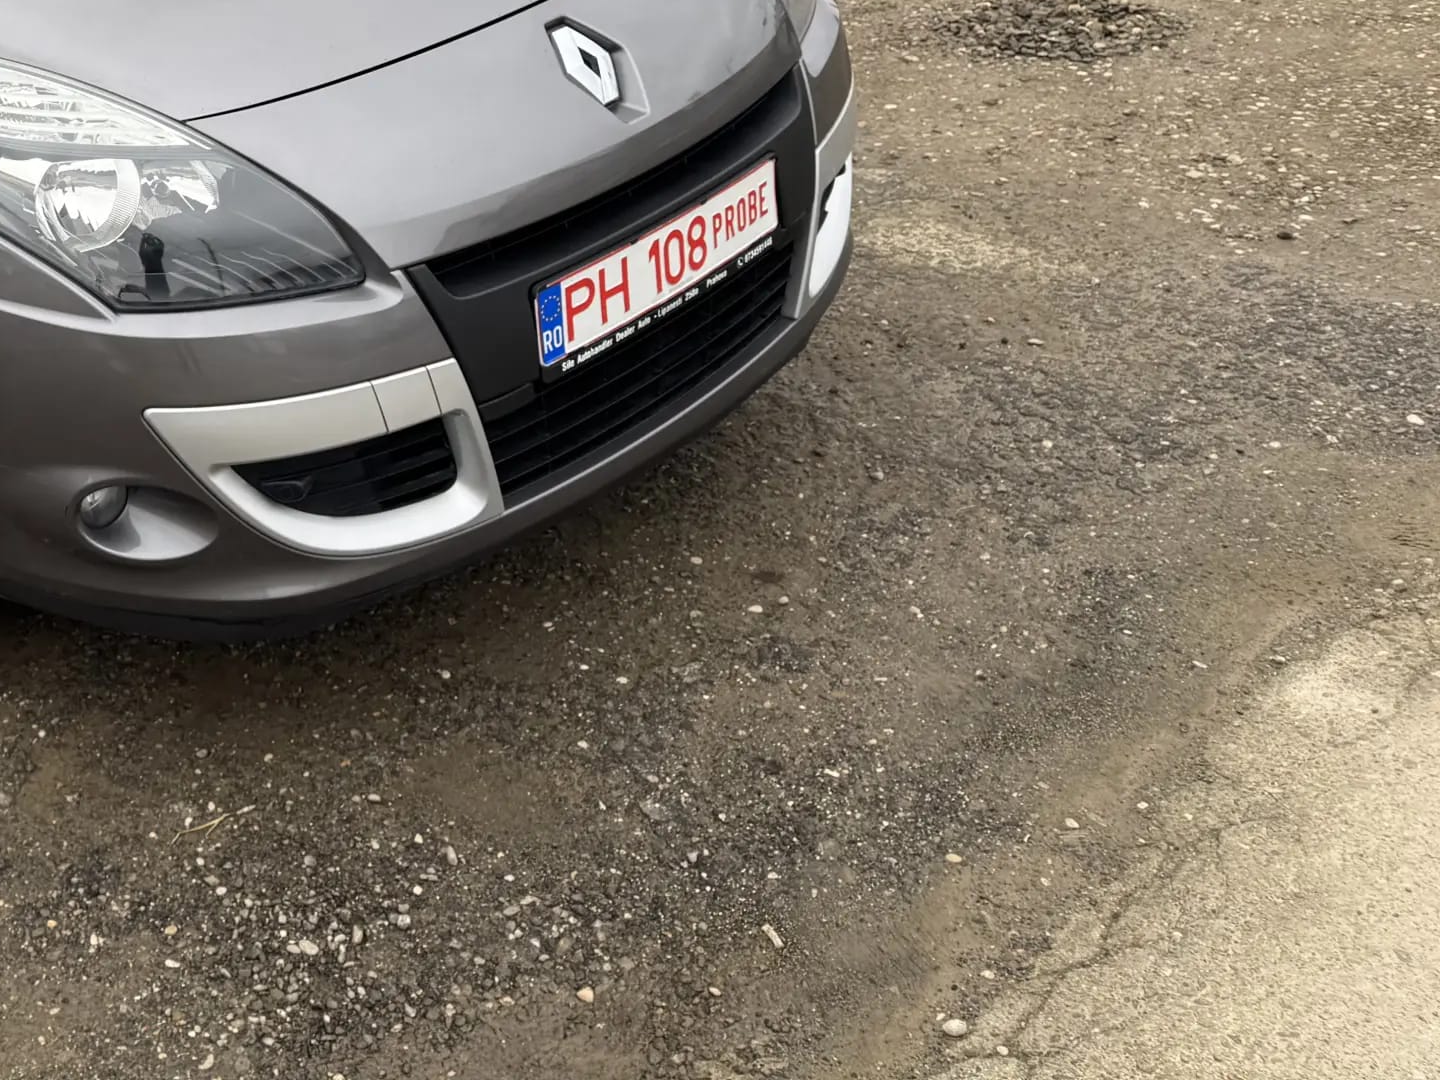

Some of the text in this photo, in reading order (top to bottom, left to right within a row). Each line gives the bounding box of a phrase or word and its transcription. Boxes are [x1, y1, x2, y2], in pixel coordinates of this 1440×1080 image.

[564, 181, 768, 343] PH 108 PROBE
[543, 325, 562, 354] RO
